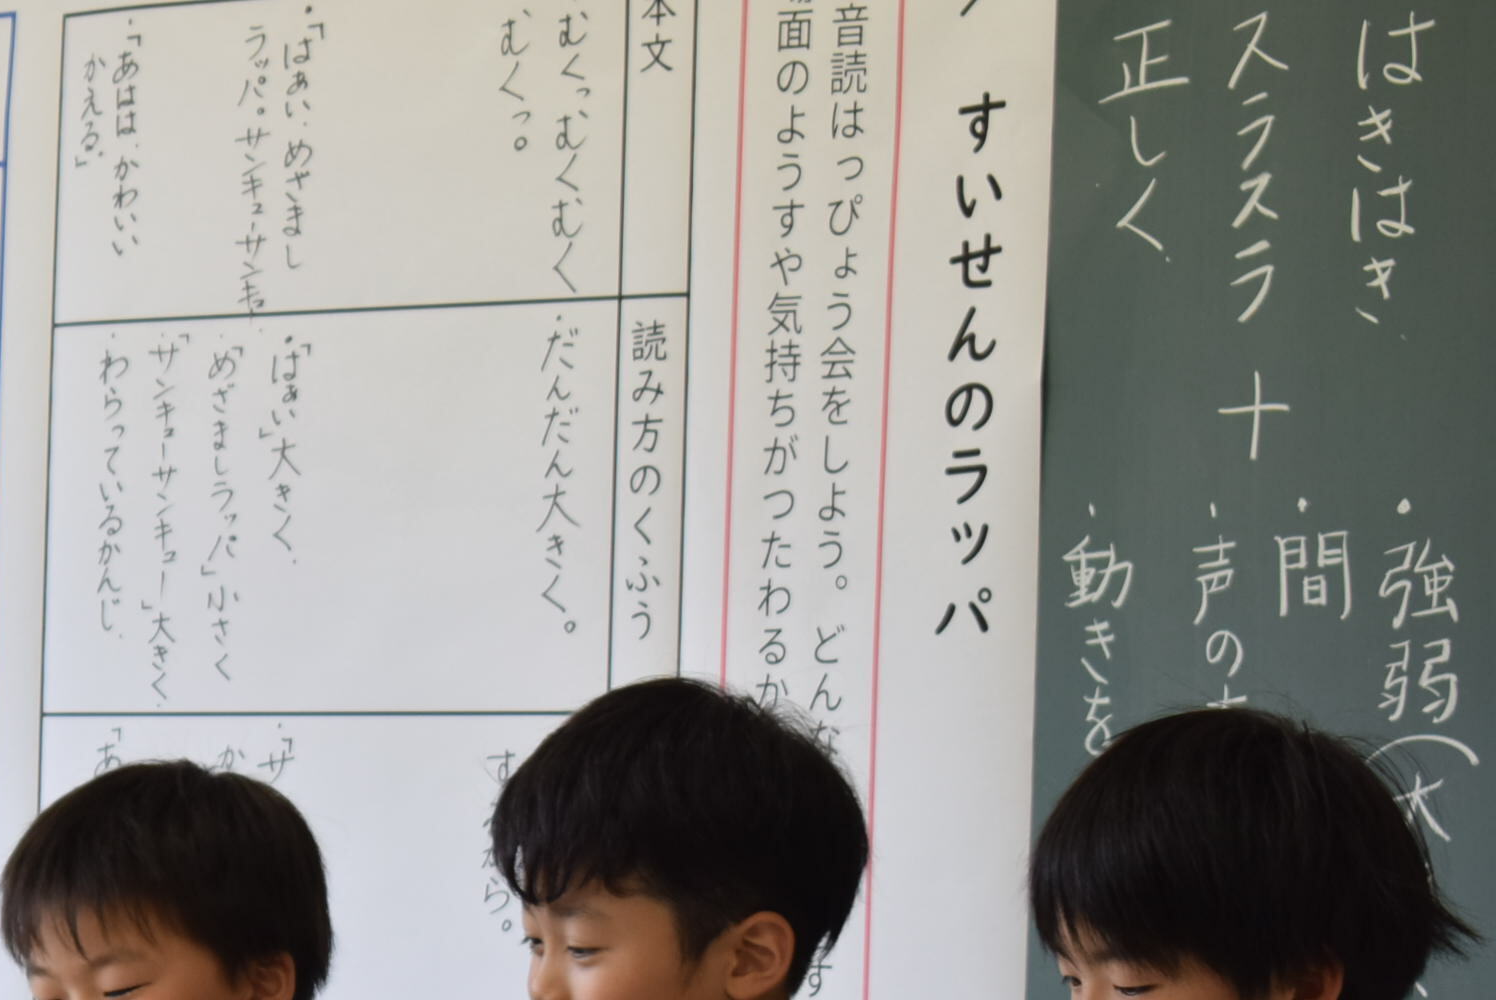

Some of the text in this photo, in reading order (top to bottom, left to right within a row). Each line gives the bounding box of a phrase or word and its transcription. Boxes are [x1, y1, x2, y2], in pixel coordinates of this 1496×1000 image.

[640, 0, 677, 73] 本文
[1098, 19, 1190, 252] 正しく
[1227, 12, 1289, 322] スラスラ
[1348, 12, 1435, 324] はきはき
[626, 320, 668, 641] 読み方のくふう
[755, 0, 814, 708] 面のようすや気持ちがつたわるか
[935, 92, 1006, 635] すいせんのラッパ
